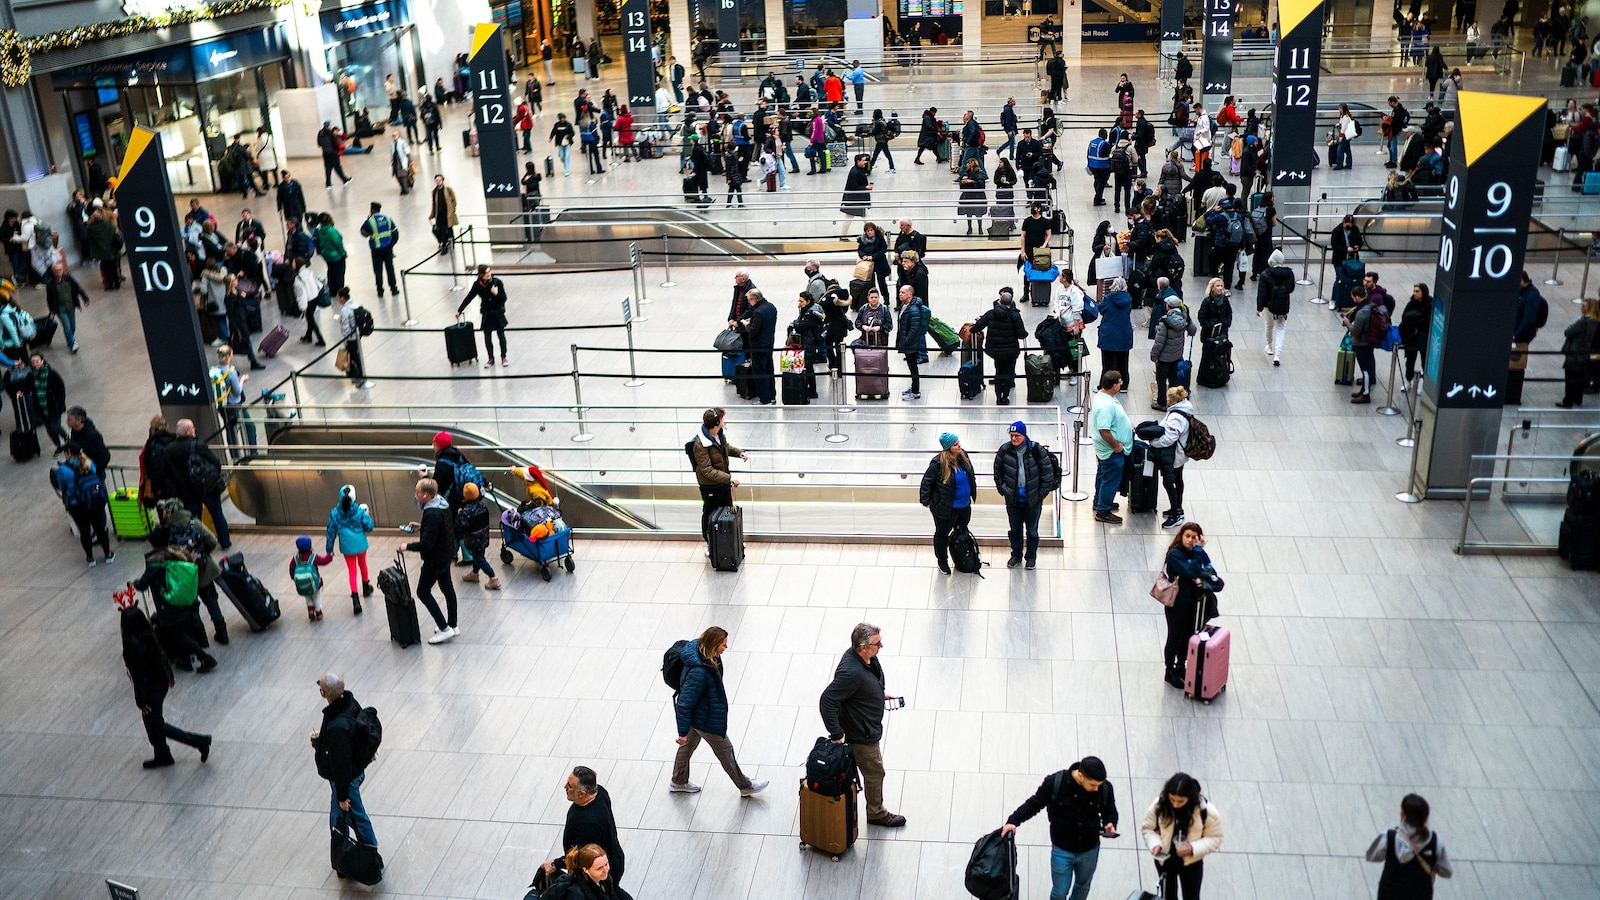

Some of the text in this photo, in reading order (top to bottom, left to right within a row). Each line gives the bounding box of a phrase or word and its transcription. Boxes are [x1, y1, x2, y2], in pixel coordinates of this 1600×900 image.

[627, 11, 645, 27] 13
[1211, 20, 1230, 37] 14
[628, 36, 647, 53] 14
[135, 60, 168, 73] Service
[1290, 47, 1310, 69] 11
[478, 69, 498, 92] 11
[1285, 84, 1311, 106] 12
[480, 103, 505, 125] 12
[1448, 174, 1459, 210] 9
[1486, 181, 1513, 217] 9
[134, 206, 156, 238] 9
[1439, 234, 1453, 272] 10
[1468, 244, 1514, 279] 10
[139, 260, 175, 292] 10
